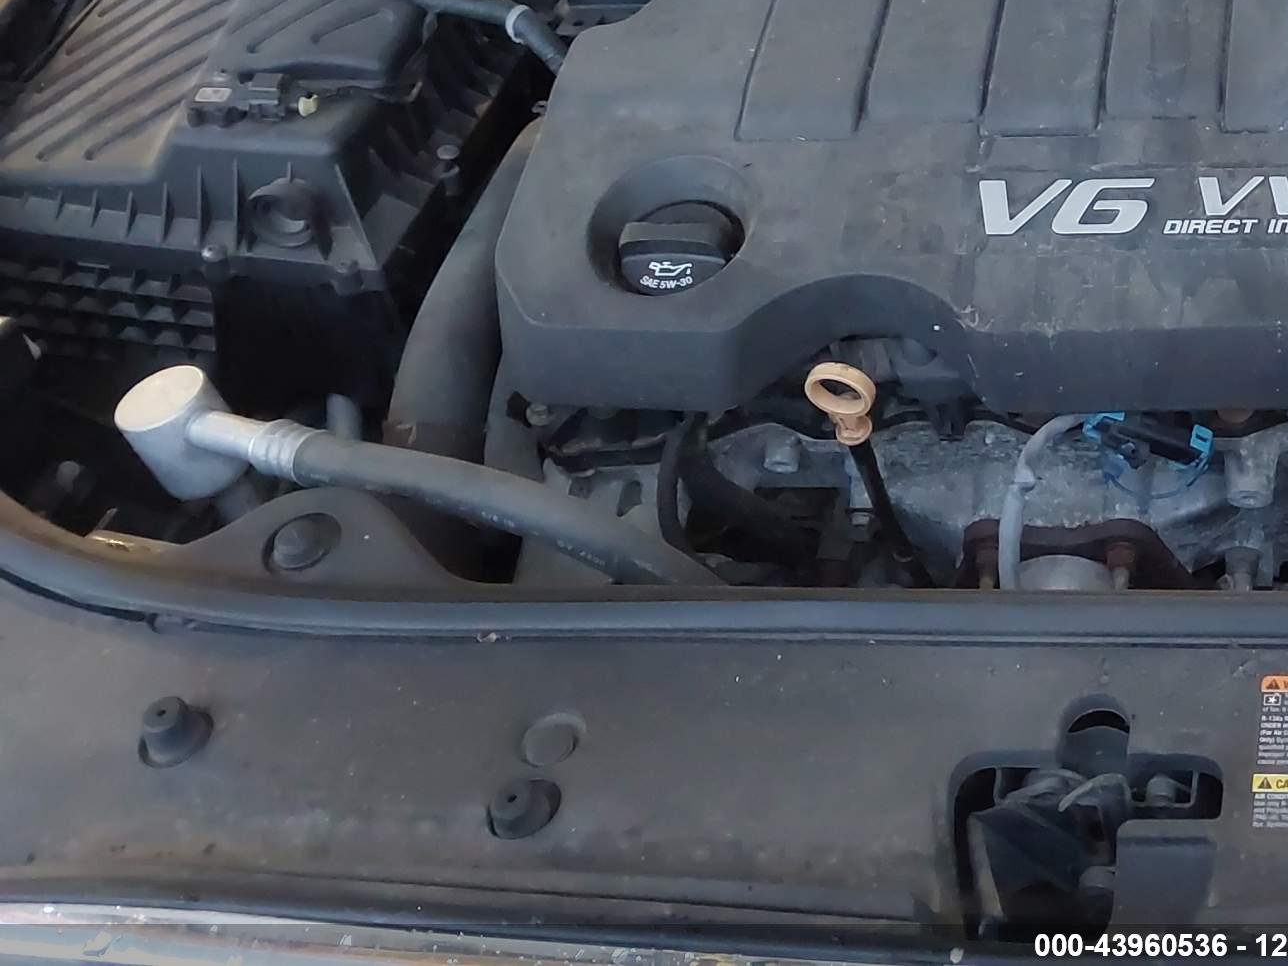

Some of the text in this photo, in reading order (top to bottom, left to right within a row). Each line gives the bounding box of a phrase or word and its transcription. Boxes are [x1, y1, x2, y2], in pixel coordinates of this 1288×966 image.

[979, 177, 1155, 236] V6
[1162, 218, 1258, 235] DIRECT
[640, 275, 693, 289] SAE 5W-30
